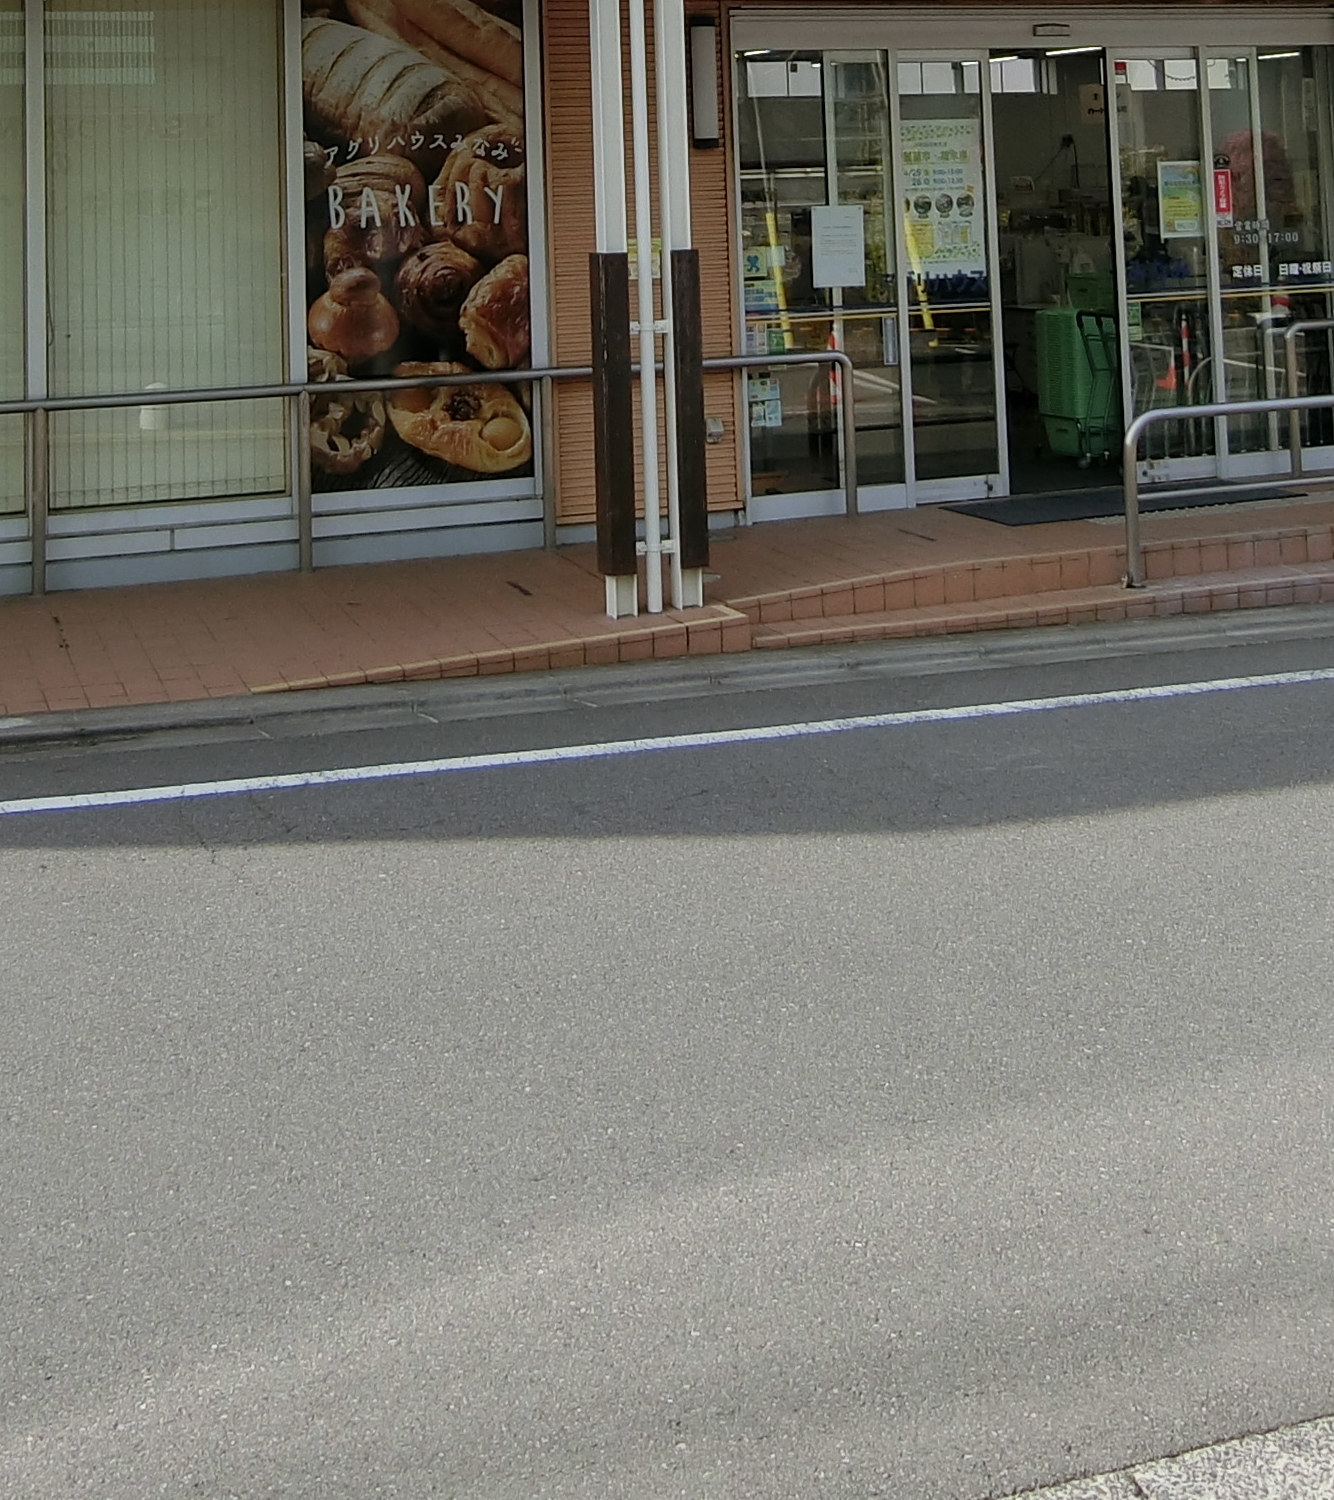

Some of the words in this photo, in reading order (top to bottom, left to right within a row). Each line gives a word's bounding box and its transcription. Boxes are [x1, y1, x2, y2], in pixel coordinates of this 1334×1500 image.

[323, 131, 509, 169] アグリハウスみなみ
[327, 181, 504, 230] BAKERY
